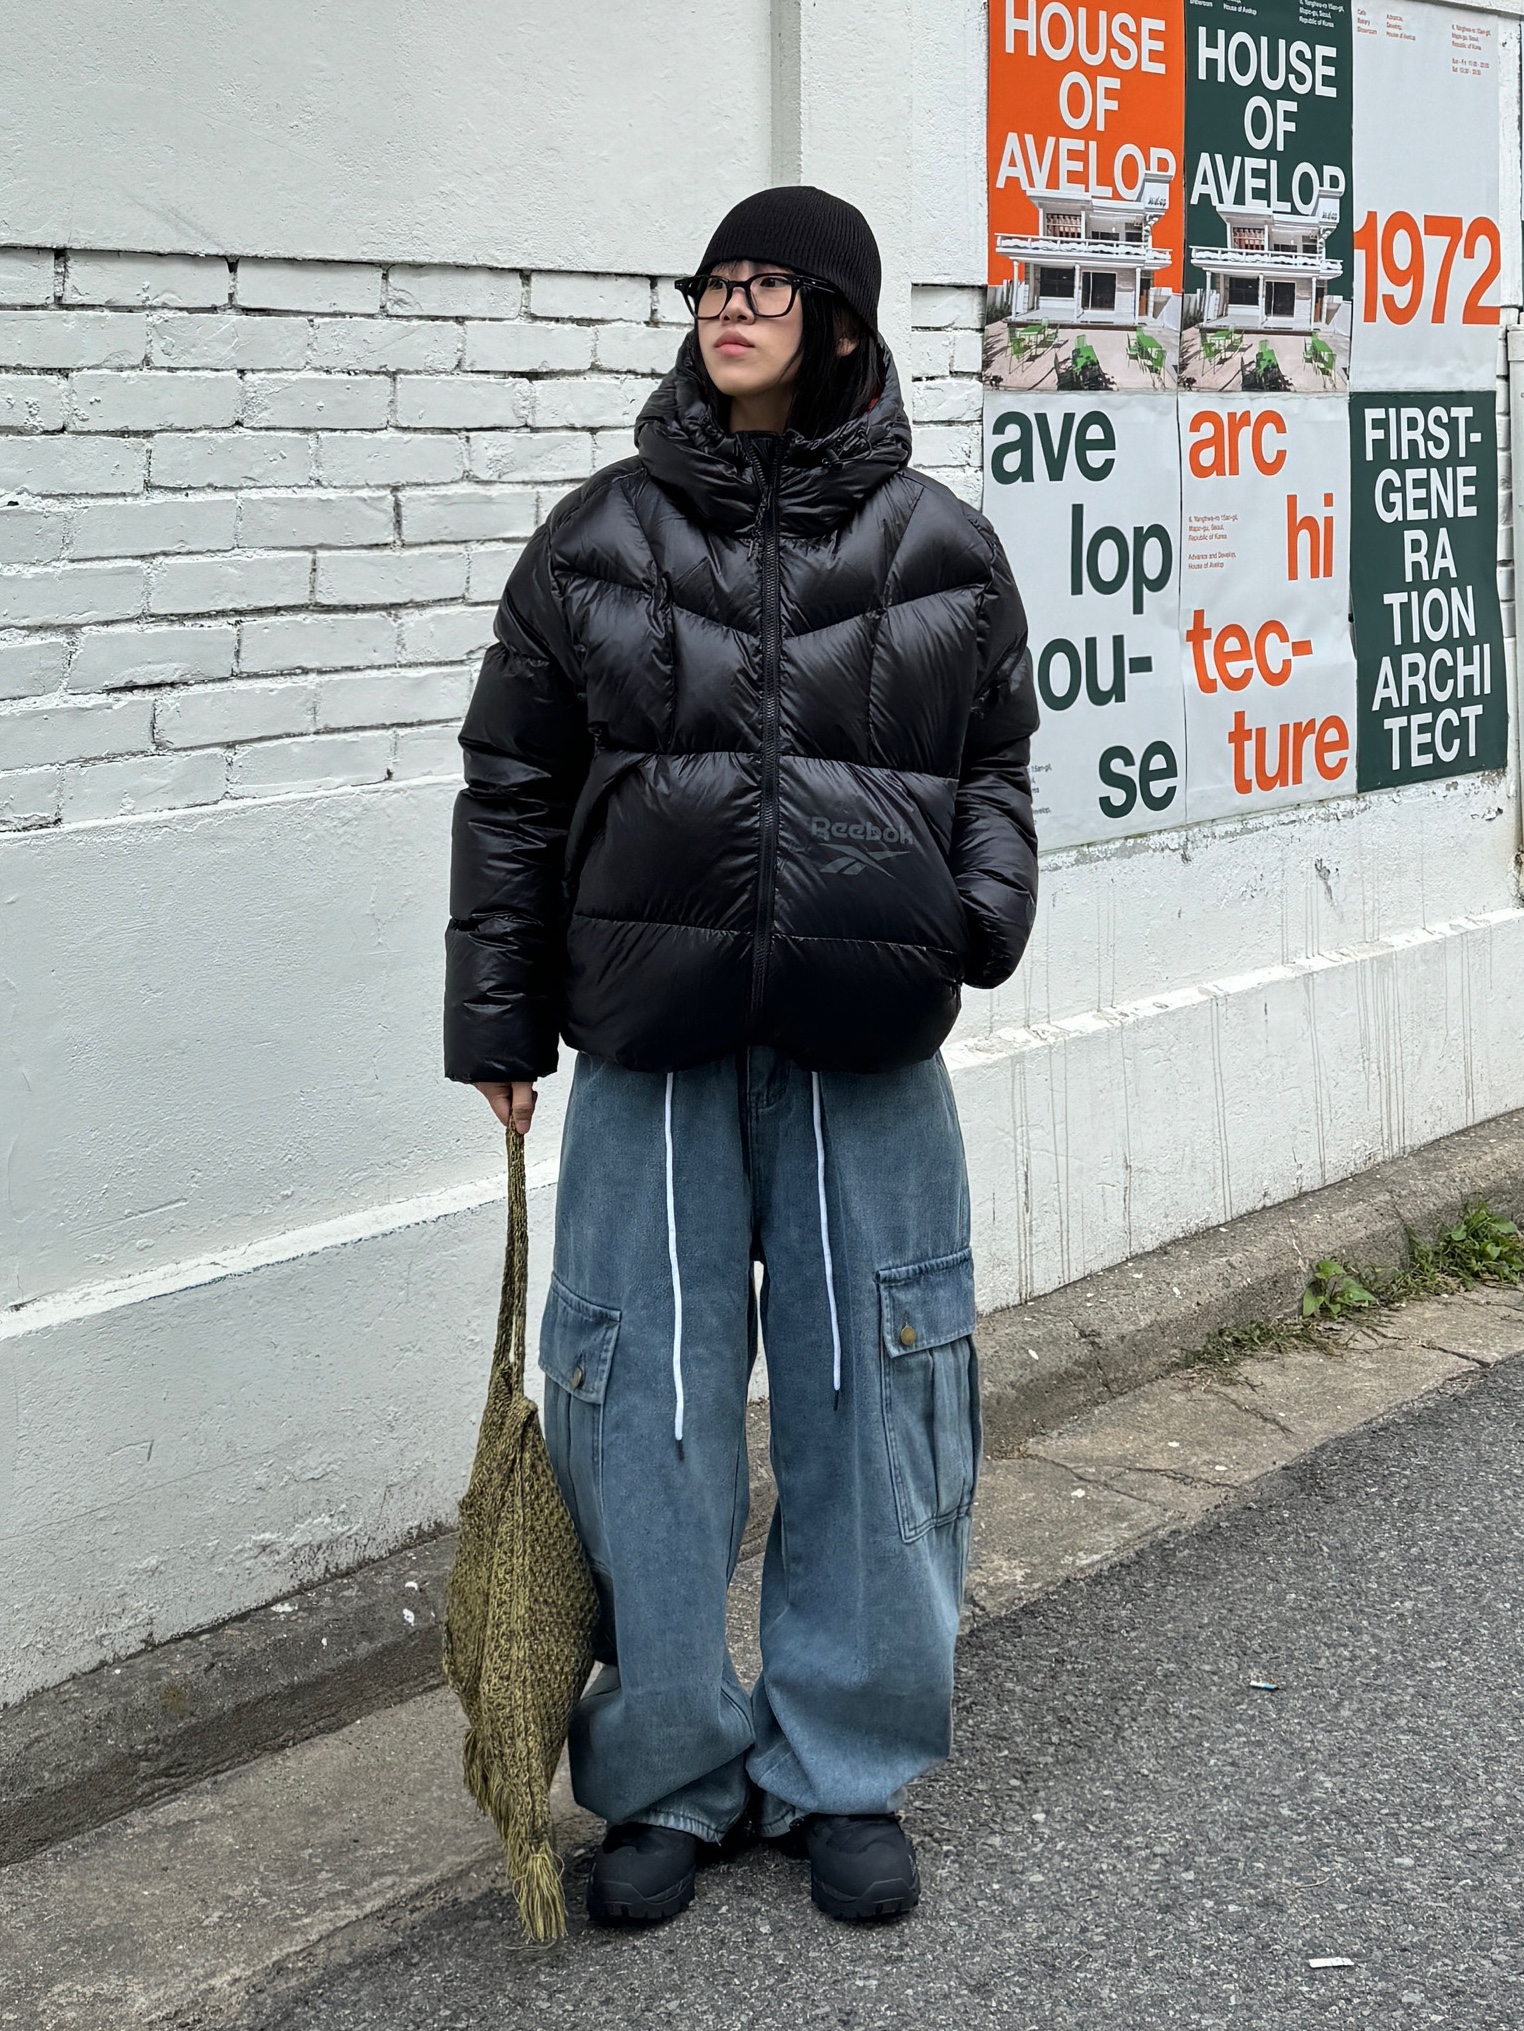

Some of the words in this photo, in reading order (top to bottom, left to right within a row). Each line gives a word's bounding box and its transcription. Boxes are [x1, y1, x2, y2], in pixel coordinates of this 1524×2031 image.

[1005, 0, 1166, 74] HOUSE
[1198, 26, 1337, 98] HOUSE
[1059, 71, 1121, 132] OF
[1244, 96, 1297, 152] OF
[995, 132, 1176, 201] AVELOP
[1190, 152, 1346, 216] AVELOP
[1354, 211, 1501, 325] 1972
[990, 410, 1116, 485] ave
[1189, 410, 1286, 479] arc
[1364, 406, 1482, 461] FIRST-
[1374, 466, 1478, 524] GENE
[1070, 503, 1173, 615] lop
[1287, 493, 1333, 581] hi
[1403, 528, 1458, 583] RA
[1383, 585, 1476, 646] TION
[1026, 634, 1153, 712] ou-
[1186, 609, 1312, 695] tec-
[1371, 643, 1492, 712] ARCHI
[1228, 711, 1350, 795] ture
[1383, 704, 1483, 771] TECT
[1098, 740, 1178, 819] se
[810, 816, 914, 845] Reebok
